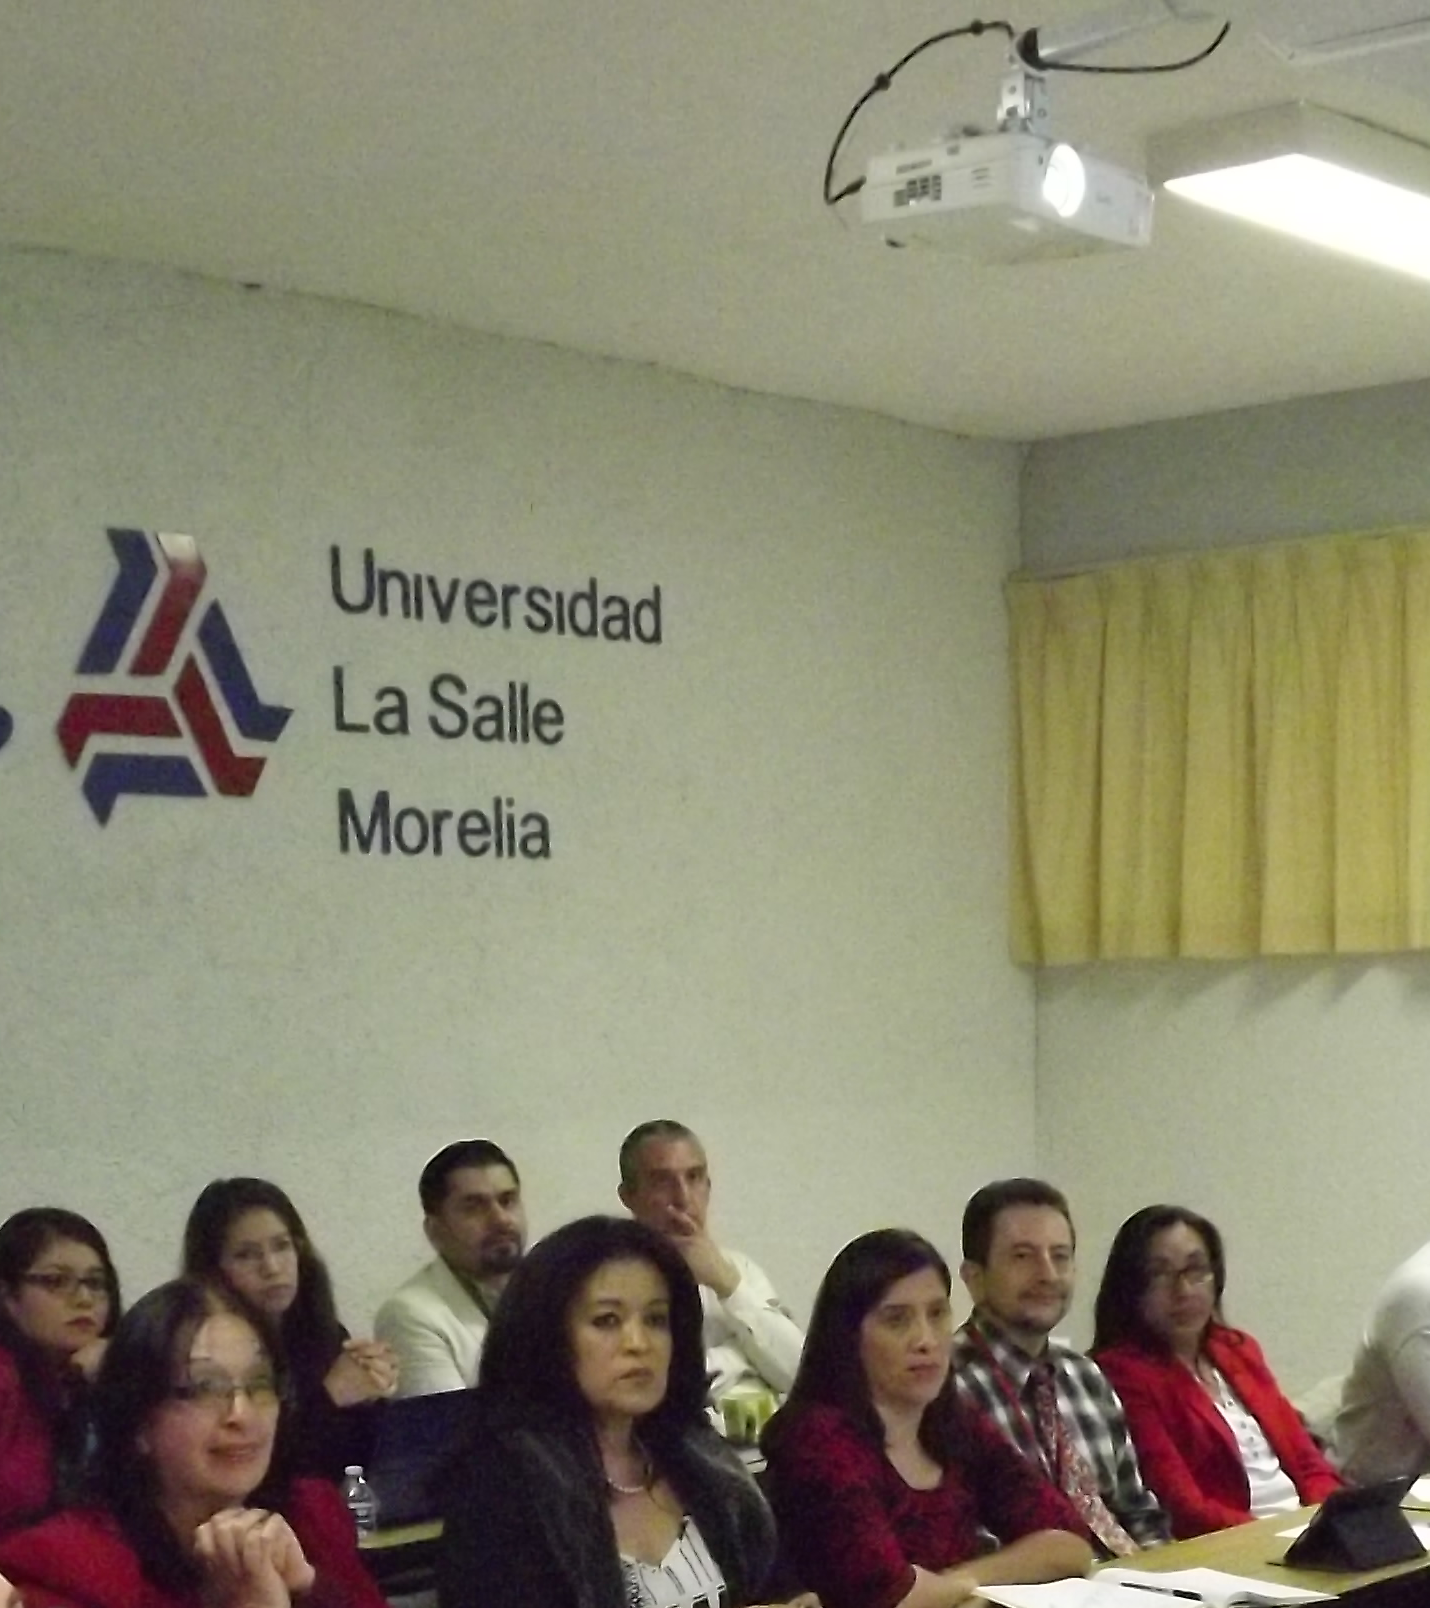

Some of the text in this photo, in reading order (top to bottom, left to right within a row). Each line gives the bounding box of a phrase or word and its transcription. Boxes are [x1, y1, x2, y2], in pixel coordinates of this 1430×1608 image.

[329, 544, 664, 645] Universidad
[332, 665, 565, 746] La Salle
[337, 787, 552, 860] Morelia
